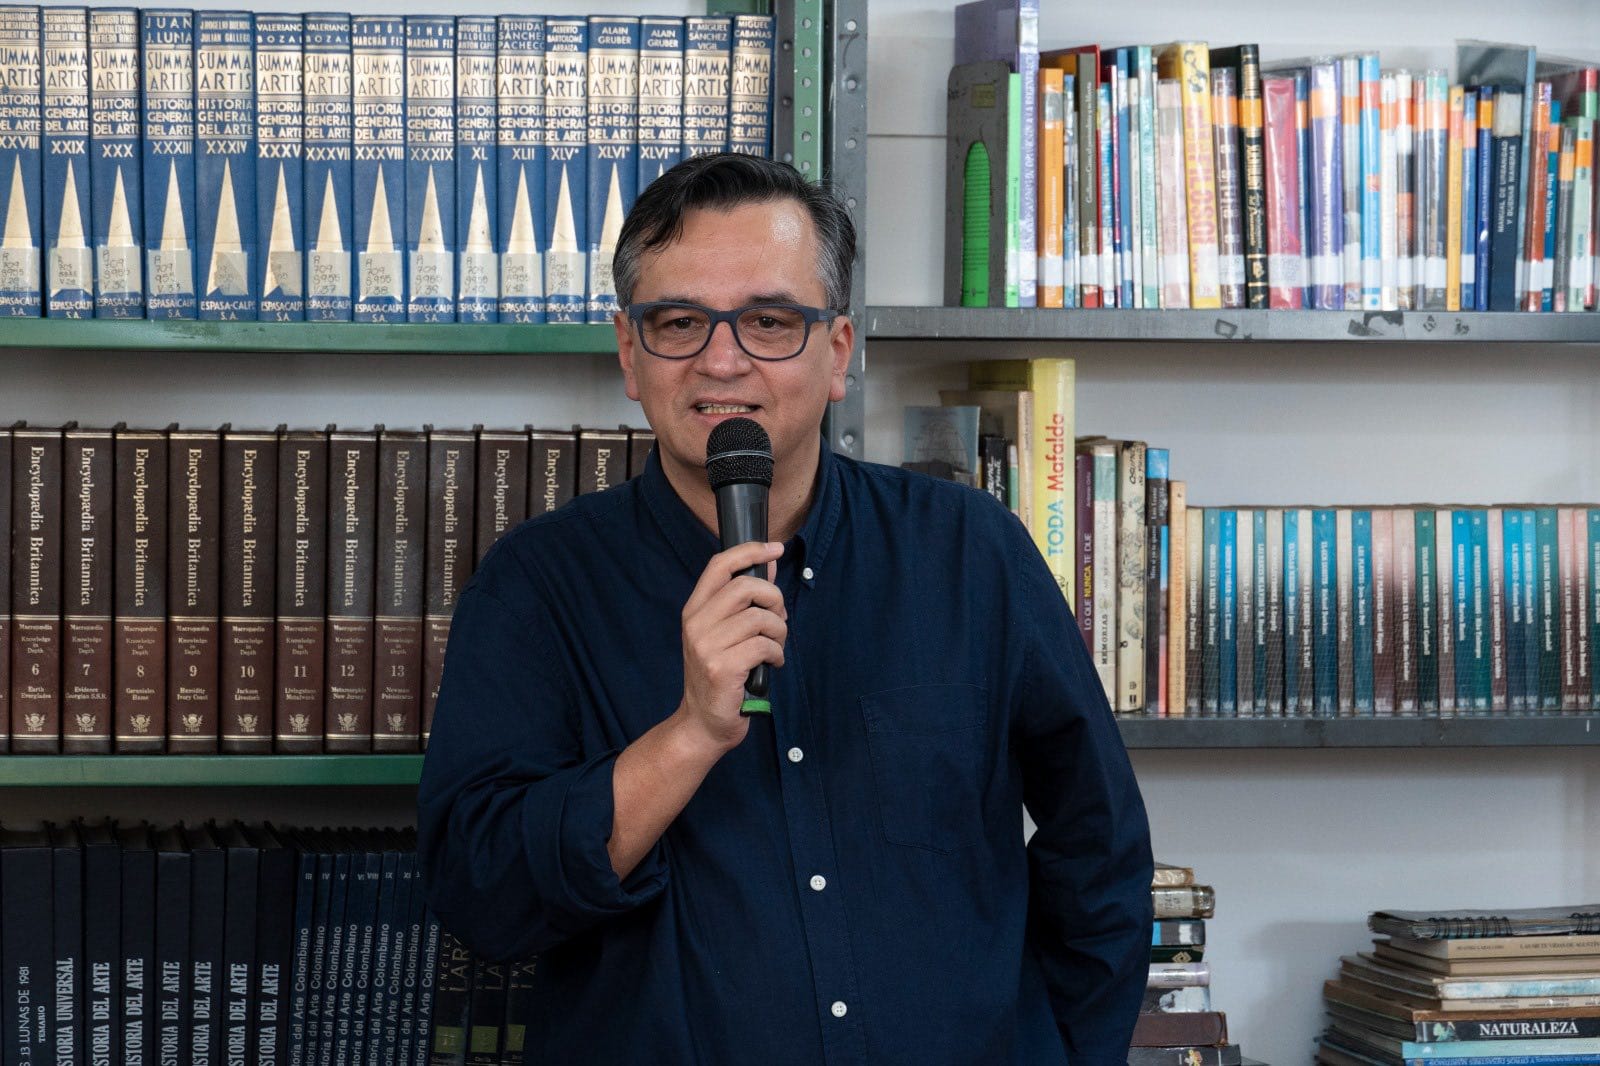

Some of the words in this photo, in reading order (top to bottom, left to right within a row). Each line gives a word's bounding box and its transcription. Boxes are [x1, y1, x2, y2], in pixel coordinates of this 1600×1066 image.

[146, 17, 191, 29] JUAN
[257, 23, 302, 32] VALERIANO
[305, 24, 349, 32] VALERIANO
[602, 27, 628, 35] ALAIN
[738, 21, 767, 29] MIGUEL
[146, 32, 153, 43] J.
[157, 32, 192, 43] LUNA
[598, 36, 631, 45] GRUBER
[652, 30, 675, 38] ALAIN
[734, 30, 772, 39] CABAÑAS
[648, 39, 678, 48] GRUBER
[738, 41, 765, 49] BRAVO
[46, 50, 87, 66] SUMMA
[93, 51, 137, 69] SUMMA
[148, 52, 192, 69] SUMMA
[199, 53, 250, 69] SUMMA
[259, 54, 302, 71] SUMMA
[305, 56, 350, 73] SUMMA
[355, 57, 401, 74] SUMMA
[590, 57, 638, 75] SUMMA
[640, 58, 682, 75] SUMMA
[734, 56, 769, 73] SUMMA
[410, 59, 450, 76] SUMMA
[686, 58, 728, 76] SUMMA
[151, 72, 192, 90] ARTIS
[201, 73, 251, 90] ARTIS
[260, 75, 302, 91] ARTIS
[308, 77, 350, 94] ARTIS
[358, 78, 400, 95] ARTIS
[411, 79, 450, 96] ARTIS
[593, 78, 636, 96] ARTIS
[642, 80, 682, 96] ARTIS
[734, 77, 769, 94] ARTIS
[147, 99, 192, 110] HISTORIA
[199, 100, 251, 110] HISTORIA
[305, 103, 350, 113] HISTORIA
[354, 103, 402, 115] HISTORIA
[407, 106, 453, 117] HISTORIA
[640, 105, 681, 115] HISTORIA
[148, 112, 192, 122] GENERAL
[199, 111, 251, 122] GENERAL
[306, 116, 350, 126] GENERAL
[355, 116, 402, 127] GENERAL
[407, 119, 452, 129] GENERAL
[640, 117, 681, 128] GENERAL
[148, 125, 167, 136] DEL
[169, 125, 192, 136] ARTE
[199, 124, 219, 135] DEL
[221, 125, 252, 135] ARTE
[305, 129, 325, 139] DEL
[328, 129, 351, 139] ARTE
[355, 128, 375, 140] DEL
[377, 128, 402, 139] ARTE
[407, 131, 427, 142] DEL
[428, 131, 453, 142] ARTE
[640, 129, 657, 140] DEL
[659, 129, 681, 140] ARTE
[52, 141, 84, 154] XXIX
[102, 144, 133, 157] XXX
[153, 141, 192, 154] XXXIII
[206, 141, 247, 154] XXXIV
[355, 147, 403, 160] XXXVIII
[410, 148, 453, 160] XXXIX
[471, 147, 488, 160] XL
[512, 147, 534, 159] XLII
[1045, 413, 1064, 491] Mafalda
[28, 446, 44, 531] Encyclopædia
[79, 446, 95, 532] Encyclopædia
[133, 447, 149, 533] Encyclopædia
[186, 448, 202, 533] Encyclopædia
[241, 449, 257, 534] Encyclopædia
[294, 449, 310, 534] Encyclopædia
[344, 449, 360, 533] Encyclopædia
[394, 450, 410, 534] Encyclopædia
[444, 449, 460, 533] Encyclopædia
[1047, 499, 1064, 557] TODA
[1083, 552, 1092, 564] TE
[30, 536, 44, 606] Britannica
[81, 537, 95, 606] Britannica
[135, 538, 149, 607] Britannica
[187, 538, 201, 607] Britannica
[243, 538, 257, 608] Britannica
[295, 538, 309, 607] Britannica
[344, 538, 359, 607] Britannica
[394, 538, 408, 607] Britannica
[1082, 565, 1092, 598] NUNCA
[1083, 600, 1092, 616] QUE
[1083, 618, 1092, 631] LO
[1100, 614, 1109, 665] MEMORIAS
[31, 663, 40, 676] 6
[82, 664, 91, 676] 7
[136, 665, 145, 677] 8
[189, 665, 198, 677] 9
[240, 665, 255, 678] 10
[293, 665, 307, 678] 11
[340, 665, 355, 677] 12
[391, 665, 405, 677] 13
[295, 928, 309, 991] Colombiano
[310, 926, 325, 989] Colombiano
[326, 926, 342, 990] Colombiano
[342, 924, 358, 987] Colombiano
[356, 925, 373, 988] Colombiano
[374, 923, 390, 987] Colombiano
[388, 931, 404, 995] Colombiano
[404, 924, 420, 988] Colombiano
[421, 924, 438, 988] Colombiano
[18, 966, 30, 985] 1981
[93, 962, 110, 993] ARTE
[126, 958, 144, 990] ARTE
[162, 961, 180, 992] ARTE
[194, 961, 212, 993] ARTE
[230, 963, 248, 995] ARTE
[261, 964, 280, 996] ARTE
[18, 989, 30, 1004] DE
[56, 957, 74, 1021] UNIVERSAL
[93, 998, 110, 1020] DEL
[126, 993, 143, 1016] DEL
[162, 998, 179, 1020] DEL
[193, 997, 210, 1019] DEL
[229, 998, 247, 1021] DEL
[260, 999, 278, 1021] DEL
[18, 1006, 31, 1042] LUNAS
[38, 1005, 46, 1043] TEMARIO
[1479, 1021, 1579, 1036] NATURALEZA
